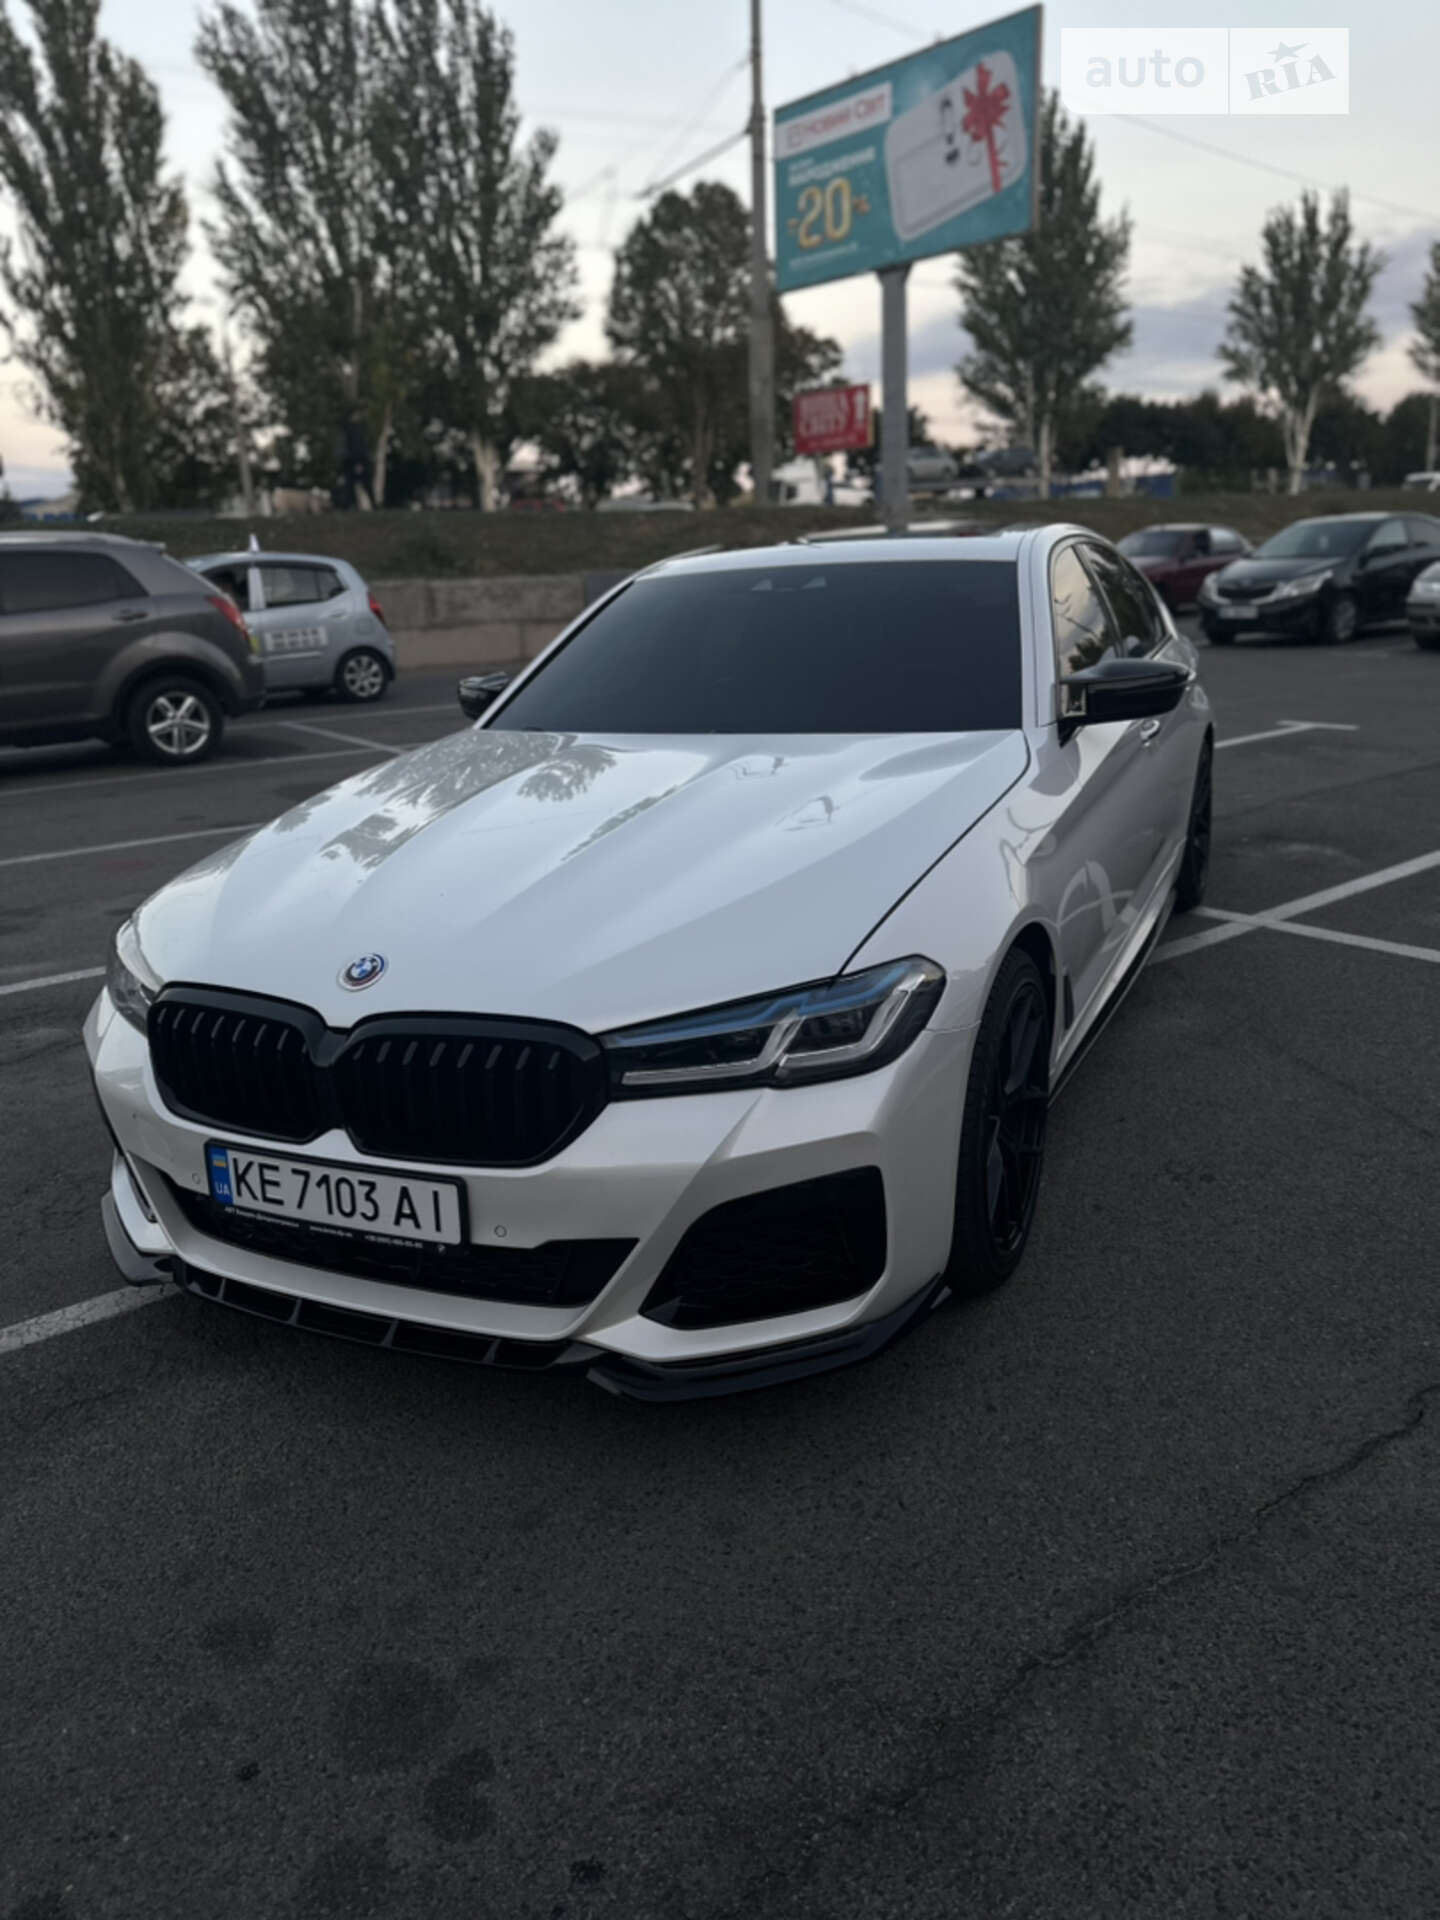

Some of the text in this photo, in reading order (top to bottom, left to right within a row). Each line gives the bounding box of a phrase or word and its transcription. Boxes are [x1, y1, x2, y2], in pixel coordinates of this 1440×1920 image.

[214, 1181, 231, 1195] UA
[233, 1157, 284, 1206] KE
[291, 1168, 380, 1222] 7103
